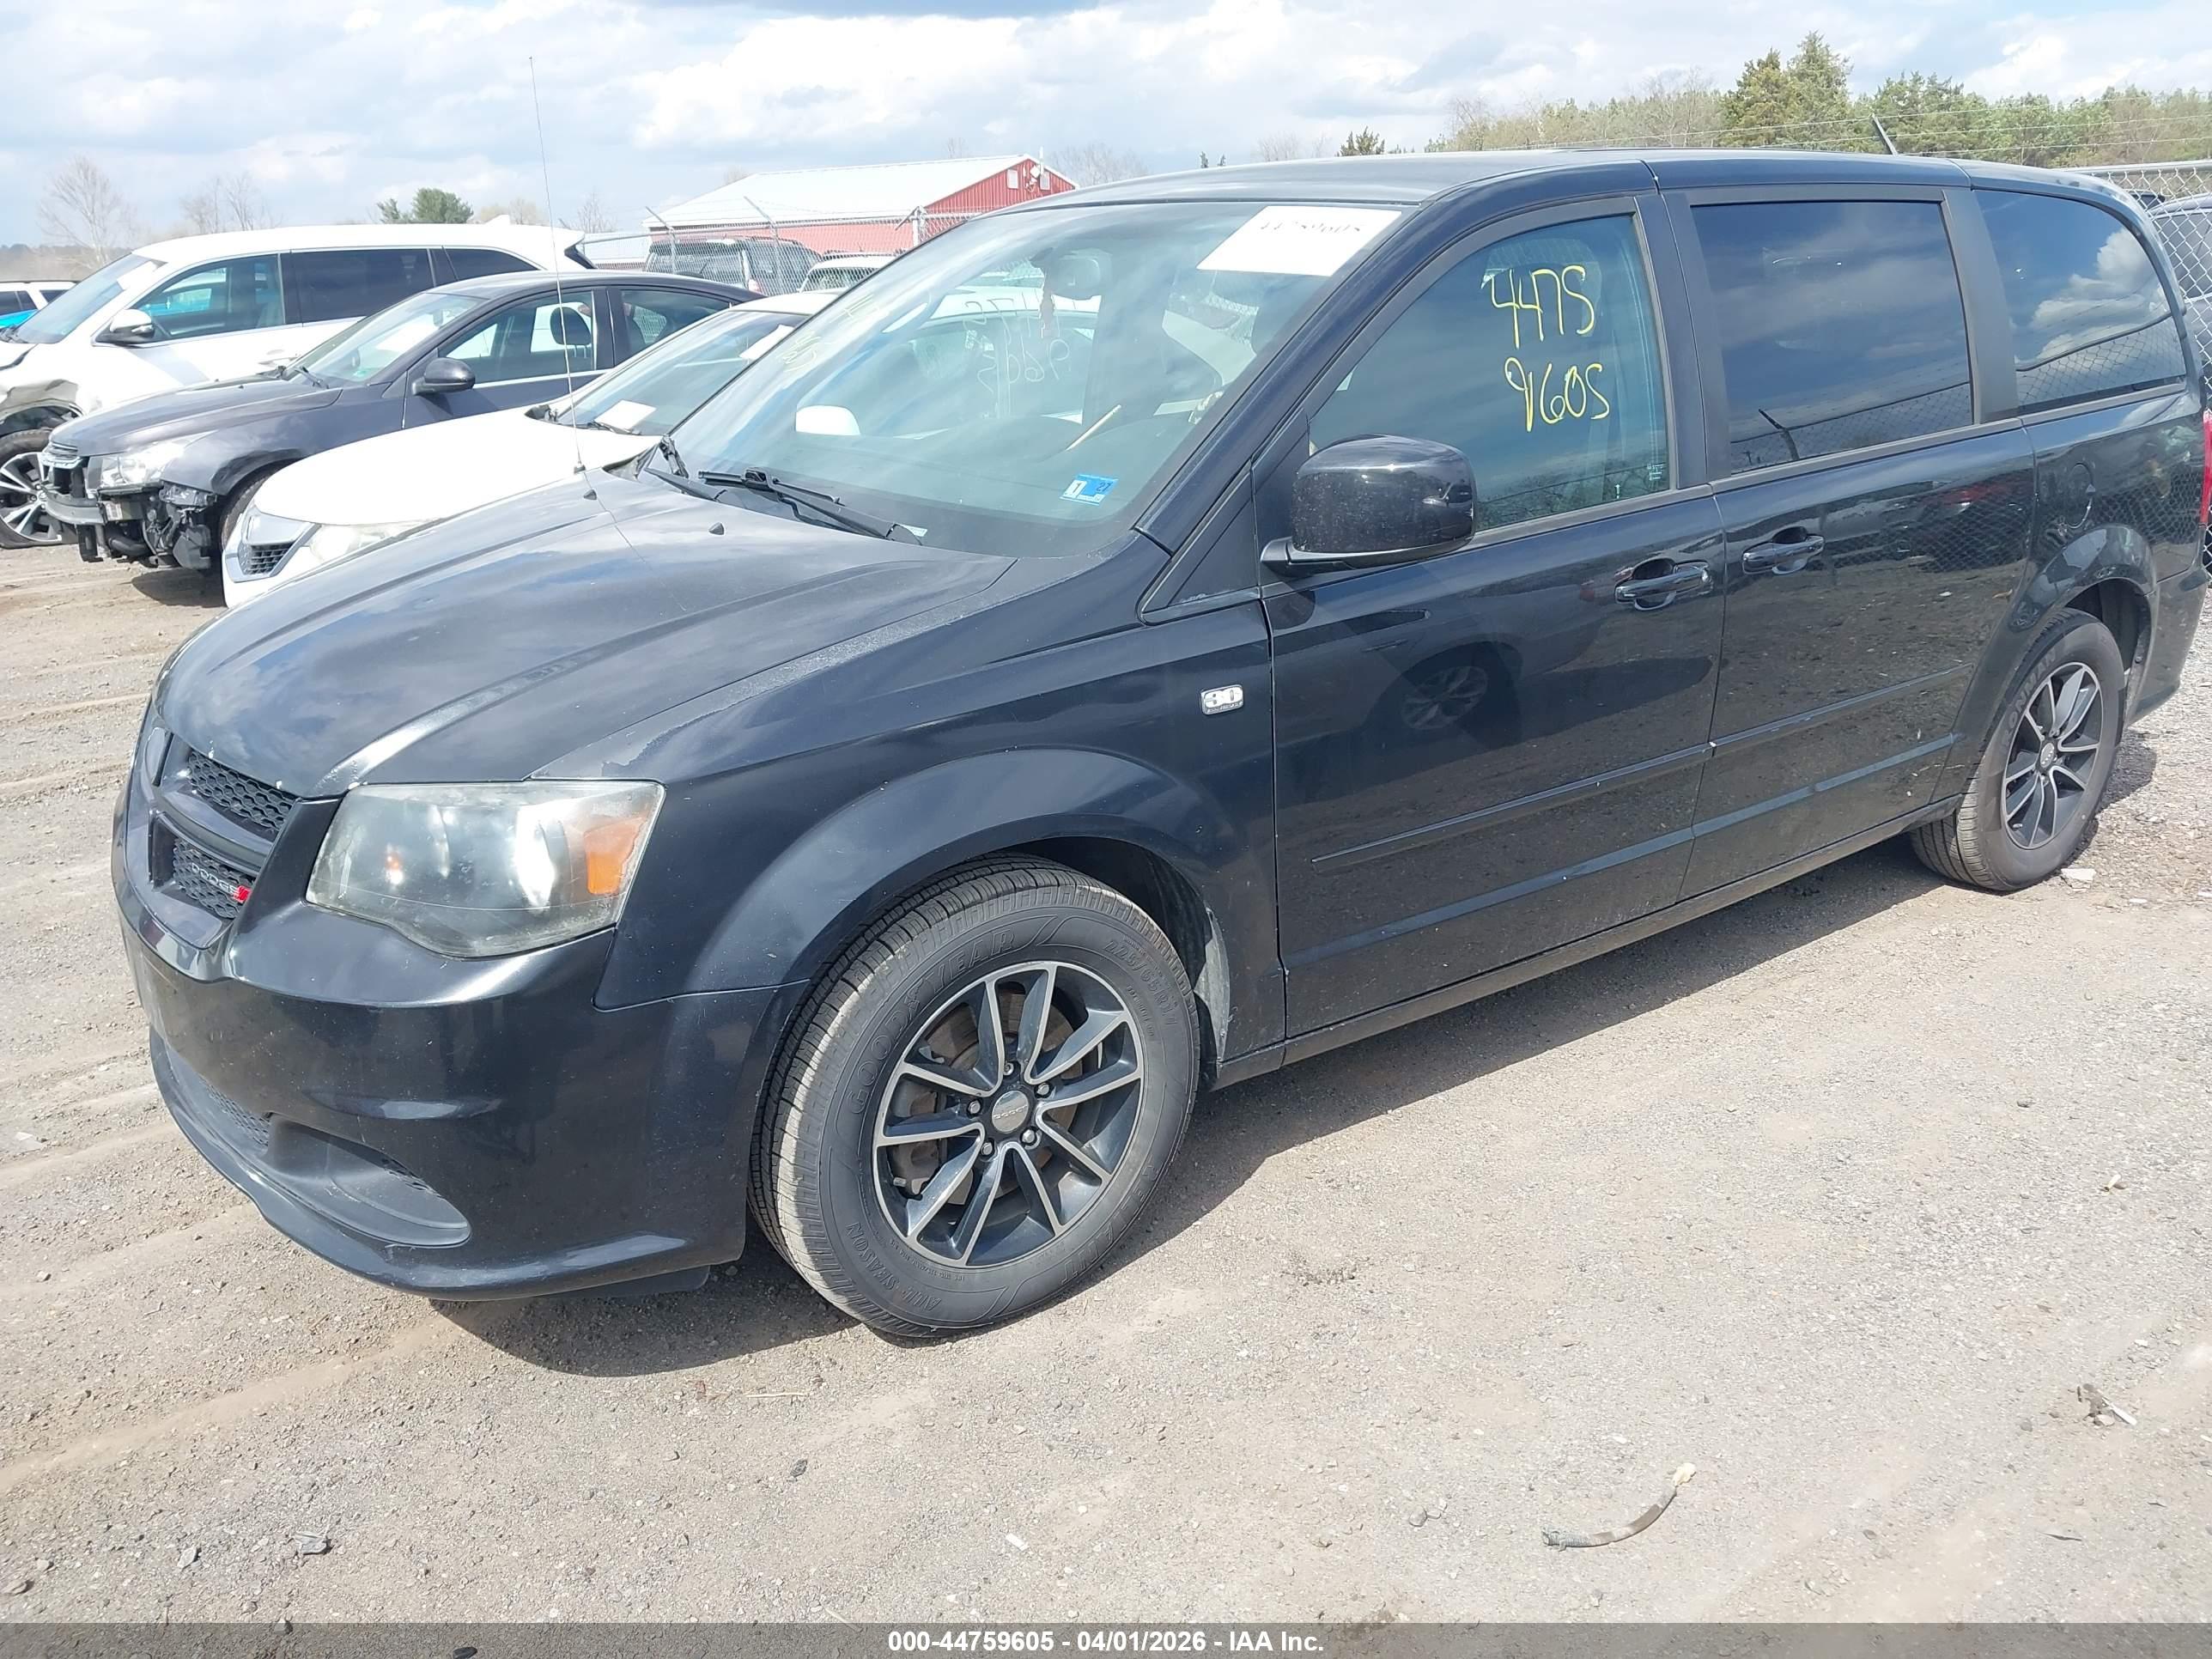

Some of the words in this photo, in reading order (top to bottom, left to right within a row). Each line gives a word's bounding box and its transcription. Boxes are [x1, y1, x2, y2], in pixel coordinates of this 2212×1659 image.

[1096, 481, 1114, 492] 27
[191, 862, 240, 896] DODGE
[845, 1221, 902, 1291] SEASON
